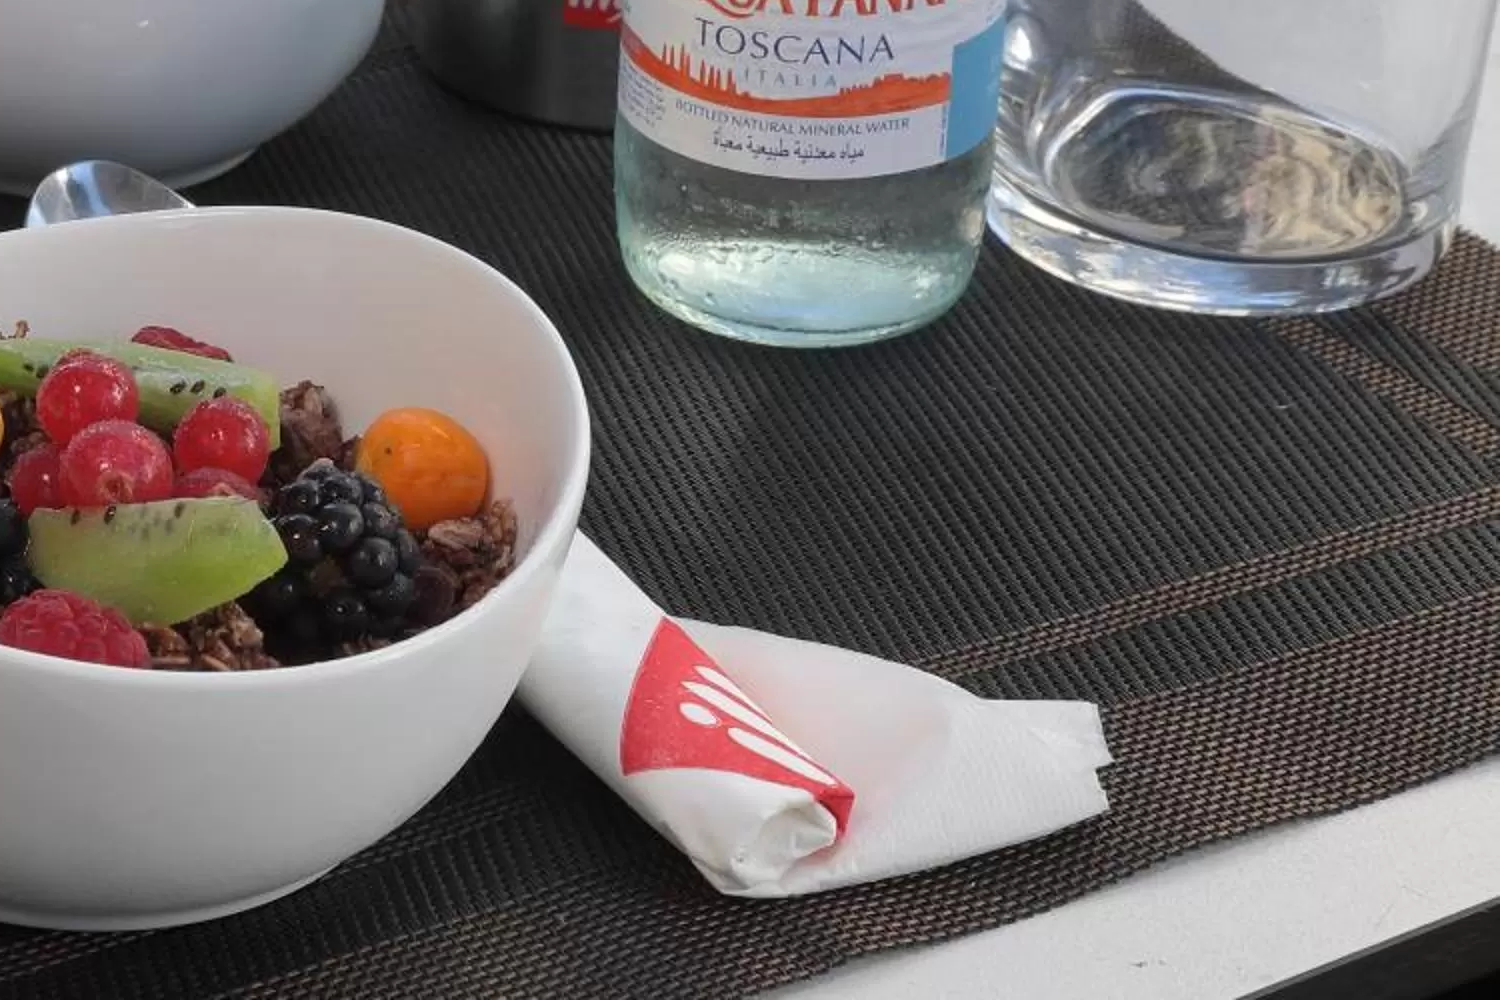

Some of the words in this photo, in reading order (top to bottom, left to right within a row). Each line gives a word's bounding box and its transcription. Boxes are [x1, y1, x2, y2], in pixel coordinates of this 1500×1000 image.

[695, 16, 894, 66] TOSCANA
[744, 69, 837, 89] ITALIA
[675, 98, 731, 123] BOTTLED
[731, 114, 795, 135] NATURAL
[799, 119, 862, 136] MINERAL
[865, 117, 912, 134] WATER
